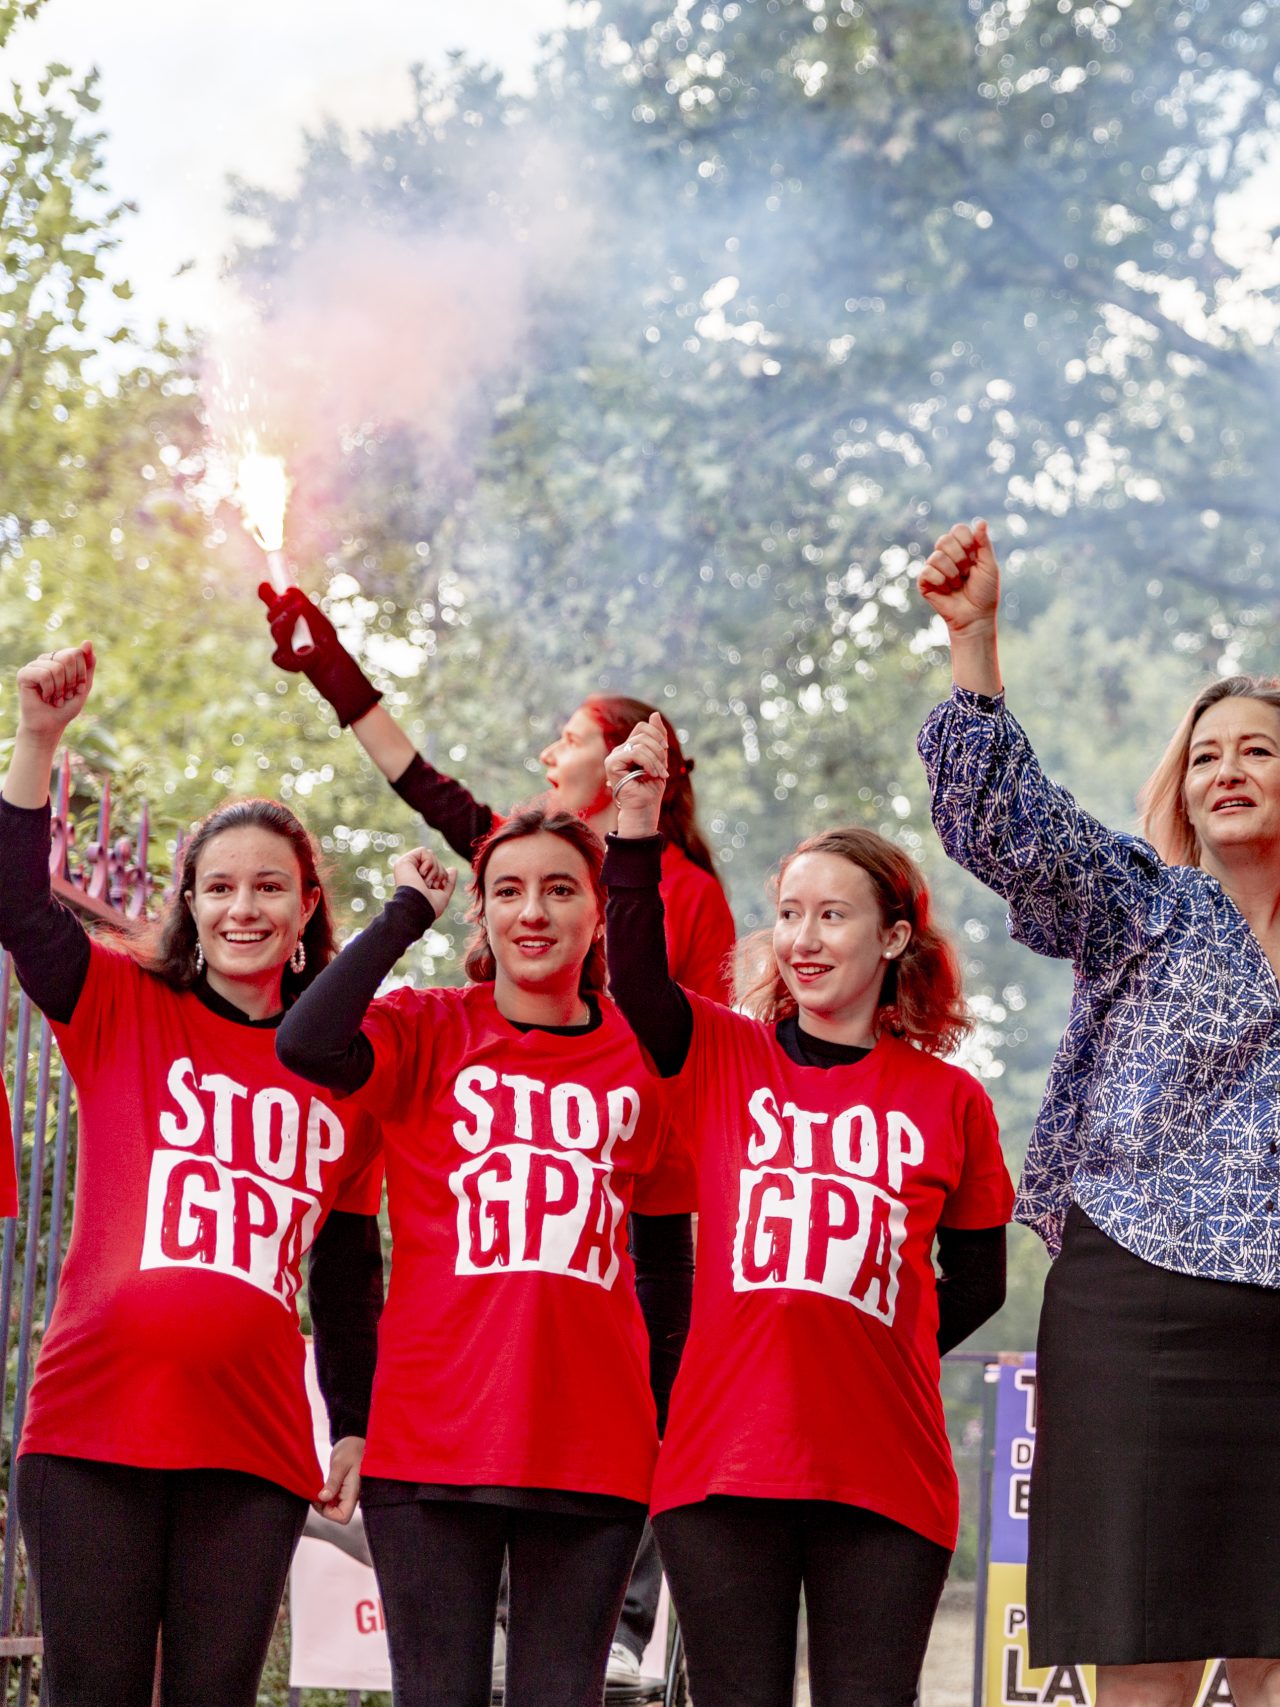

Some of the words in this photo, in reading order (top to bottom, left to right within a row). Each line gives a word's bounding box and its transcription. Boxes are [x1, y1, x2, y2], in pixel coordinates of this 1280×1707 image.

[159, 1057, 345, 1193] STOP
[453, 1065, 640, 1165] STOP
[748, 1087, 925, 1194] STOP
[462, 1152, 613, 1279] GPA
[742, 1173, 892, 1315] GPA
